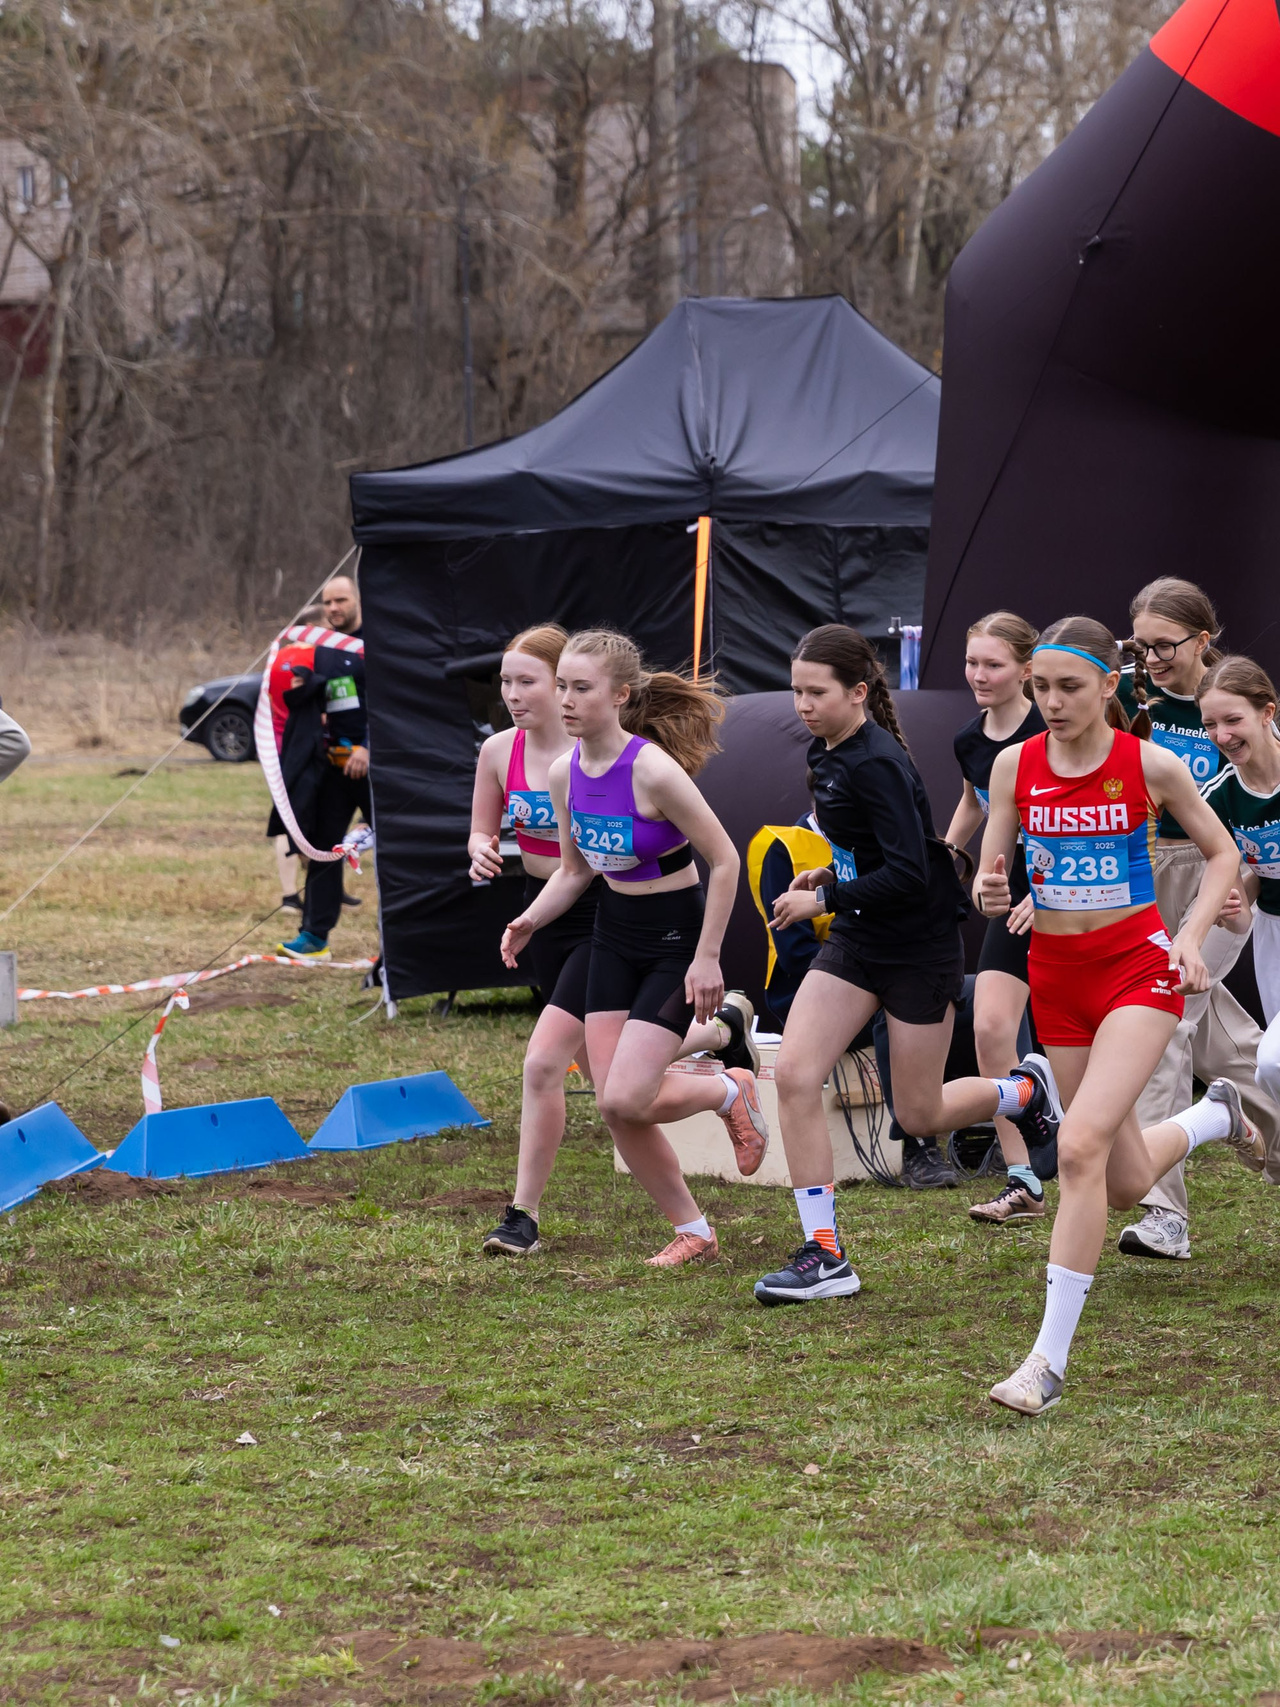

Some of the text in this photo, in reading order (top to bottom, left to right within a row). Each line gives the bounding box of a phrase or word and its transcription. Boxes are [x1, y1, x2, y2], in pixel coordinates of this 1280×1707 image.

[1151, 721, 1166, 731] os
[1167, 723, 1210, 739] Angele
[1193, 742, 1212, 752] 2025
[1180, 753, 1210, 778] 40
[1029, 803, 1129, 833] RUSSIA
[585, 828, 625, 853] 242
[1094, 841, 1116, 850] 2025
[833, 858, 855, 882] 241
[1060, 855, 1119, 881] 238
[1150, 987, 1172, 996] erima
